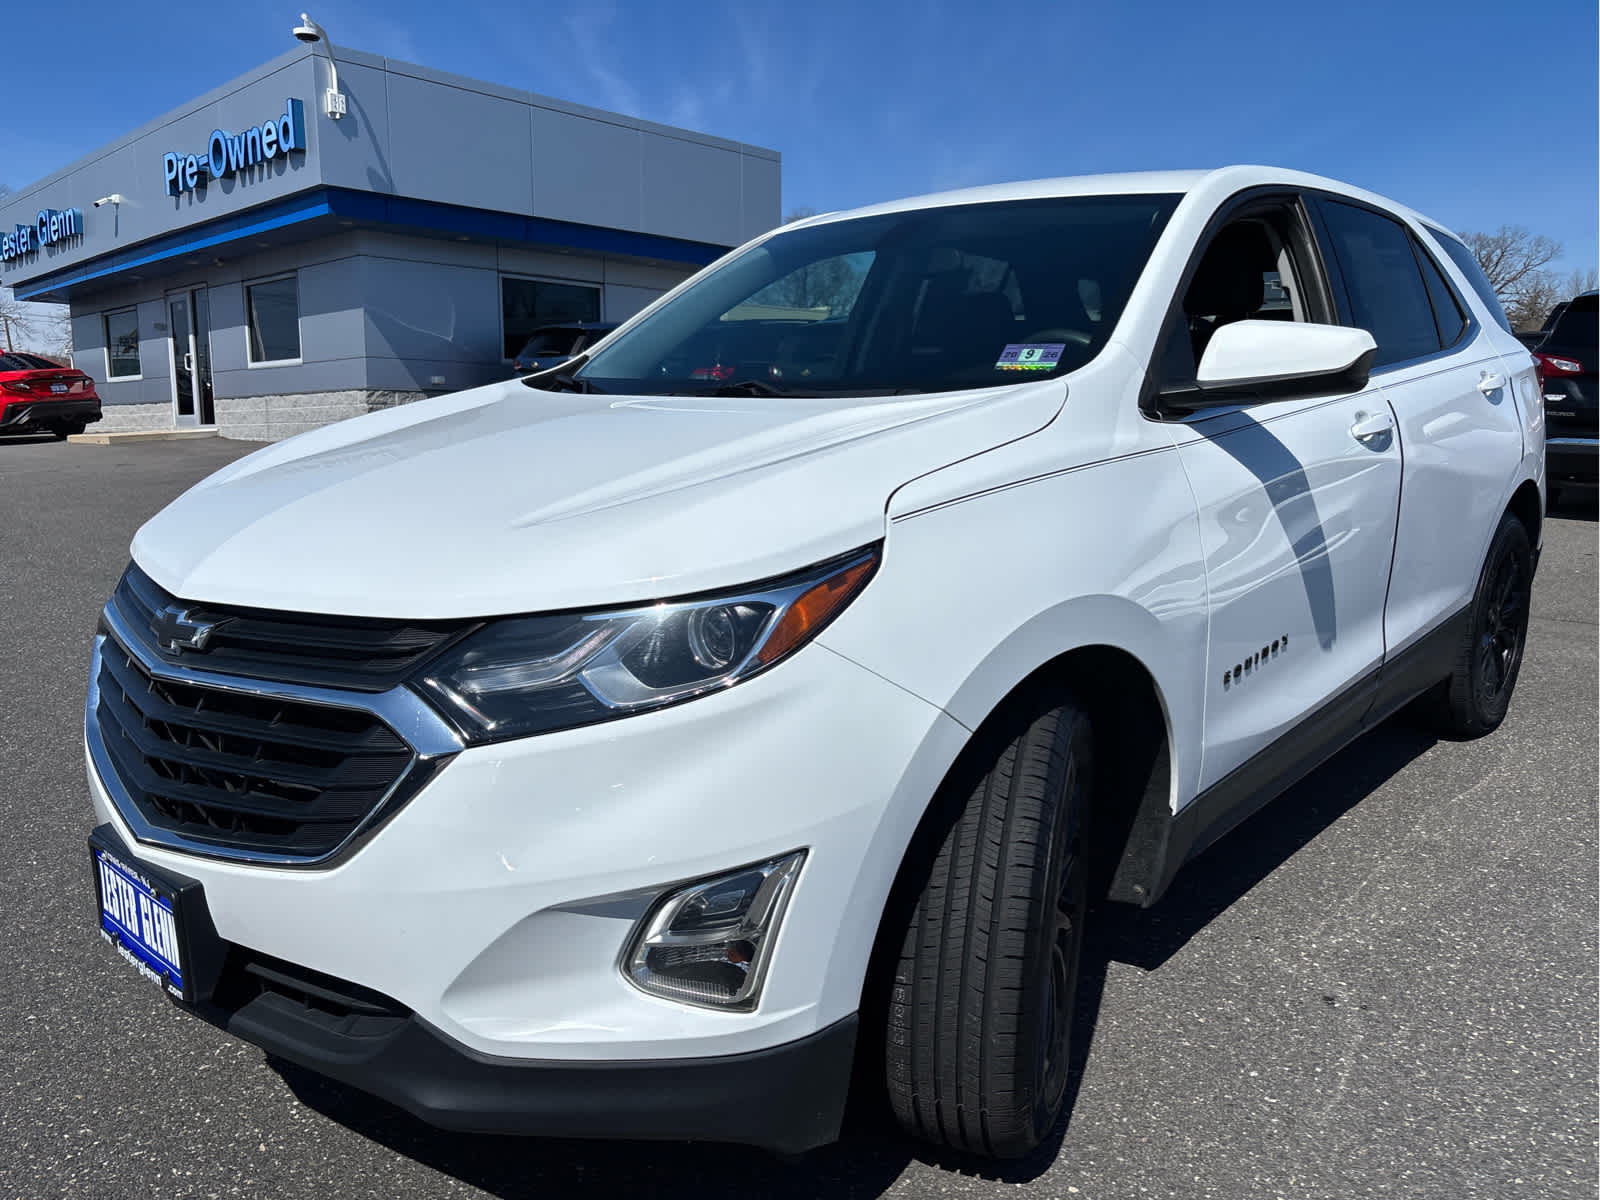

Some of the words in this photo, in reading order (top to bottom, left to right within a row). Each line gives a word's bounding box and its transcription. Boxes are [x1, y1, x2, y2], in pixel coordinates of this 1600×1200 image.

[164, 98, 297, 196] Pre-Owned
[37, 208, 76, 247] Glenn
[1024, 349, 1035, 359] 9
[1223, 632, 1289, 686] EQUINOX
[99, 860, 140, 938] LESTER
[139, 892, 181, 970] GLENN
